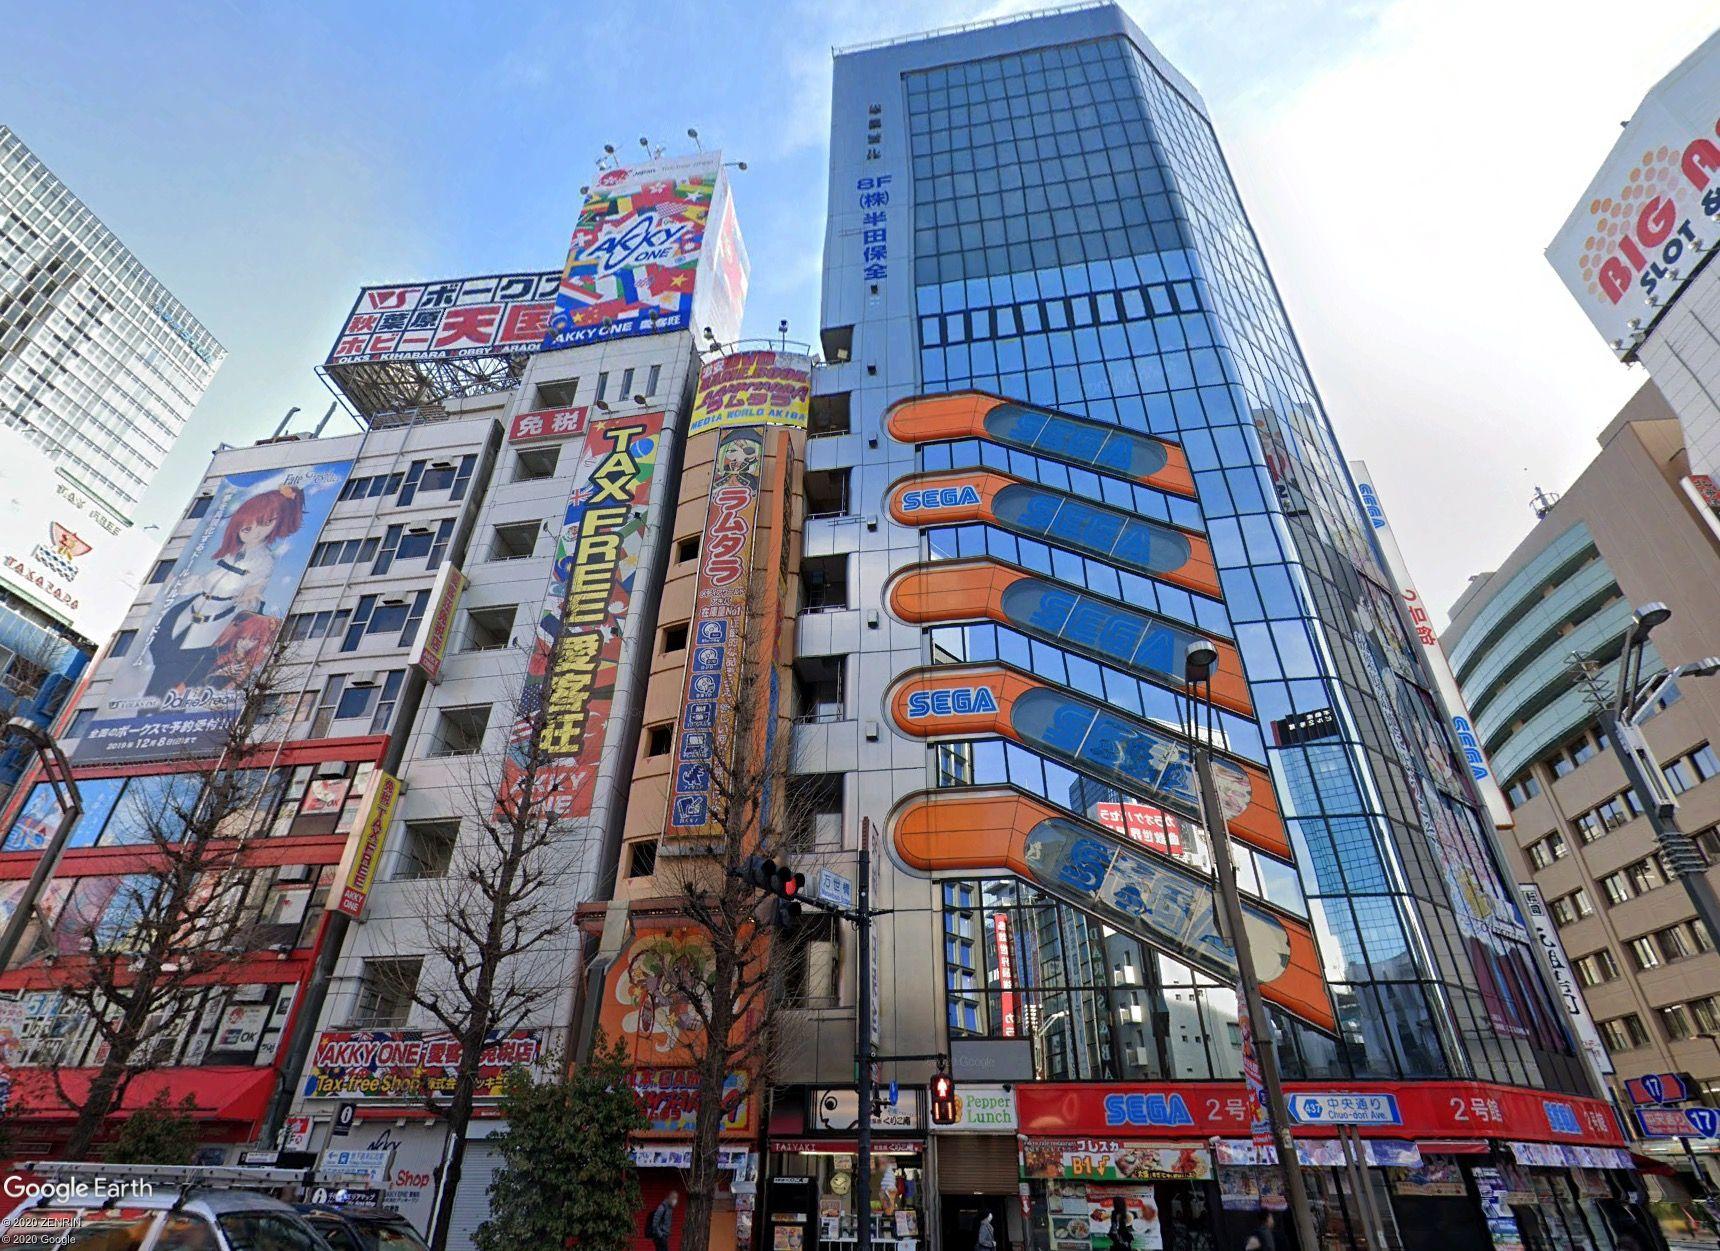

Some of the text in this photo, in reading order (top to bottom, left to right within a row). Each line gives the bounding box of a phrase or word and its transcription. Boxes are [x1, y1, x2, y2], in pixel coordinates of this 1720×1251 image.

[857, 175, 892, 190] 8F
[859, 191, 889, 281] (株)半田保全
[634, 246, 674, 262] ONE
[1599, 195, 1676, 305] BIG
[1640, 219, 1696, 295] SLOT
[348, 310, 442, 334] 秋葉原
[553, 327, 597, 344] AKKY
[598, 322, 633, 336] ONE
[336, 334, 430, 355] ホビー
[517, 411, 577, 437] 免税
[690, 415, 722, 430] MEDIA
[727, 408, 764, 419] WORLD
[590, 424, 645, 504] TAX
[902, 485, 981, 511] SEGA
[1358, 482, 1386, 529] SEGA
[702, 486, 752, 588] ラムタラ
[566, 506, 632, 624] FREE
[908, 686, 999, 718] SEGA
[1452, 715, 1489, 781] SEGA
[343, 900, 359, 912] ONE
[344, 889, 363, 902] AKKY
[240, 1032, 259, 1043] OK
[318, 1041, 376, 1067] AKKY
[377, 1041, 423, 1067] ONE
[316, 1074, 379, 1093] Tax-free
[1646, 1079, 1661, 1096] 17
[966, 1095, 1011, 1109] Pepper
[1104, 1092, 1252, 1126] SEGA 2号
[1304, 1103, 1321, 1114] 437
[1327, 1098, 1381, 1110] 中央通り
[1450, 1098, 1503, 1122] 2号館
[967, 1110, 1012, 1124] Lunch
[1371, 1111, 1388, 1119] Ave.
[1690, 1111, 1712, 1130] 17
[775, 1143, 816, 1151] TAIYAKI
[1072, 1156, 1092, 1175] B1
[395, 1169, 430, 1187] Shop
